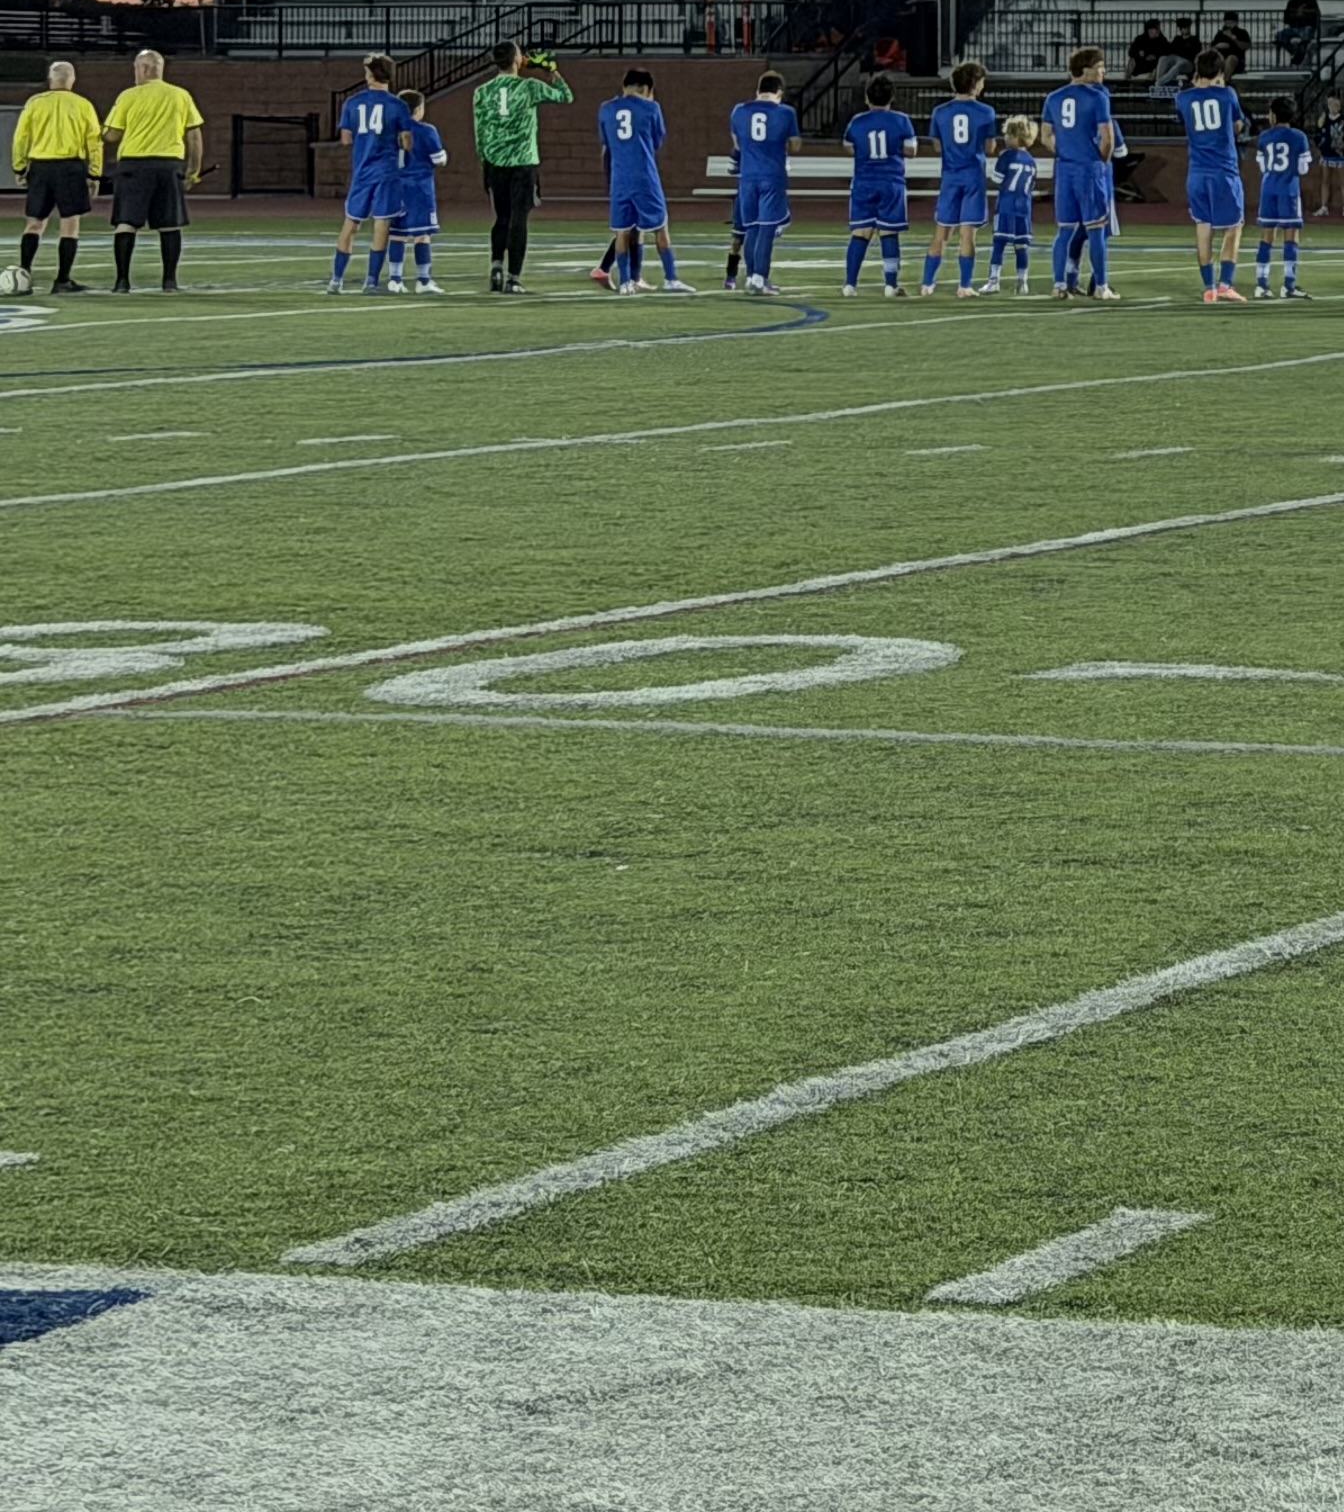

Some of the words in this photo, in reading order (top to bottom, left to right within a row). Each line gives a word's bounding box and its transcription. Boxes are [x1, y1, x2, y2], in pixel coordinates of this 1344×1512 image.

[499, 90, 510, 117] 1
[1062, 98, 1075, 127] 9
[1192, 99, 1221, 131] 10
[358, 104, 383, 134] 14
[616, 110, 632, 139] 3
[751, 113, 766, 141] 6
[953, 115, 968, 143] 8
[868, 131, 887, 158] 11
[1266, 143, 1289, 171] 13
